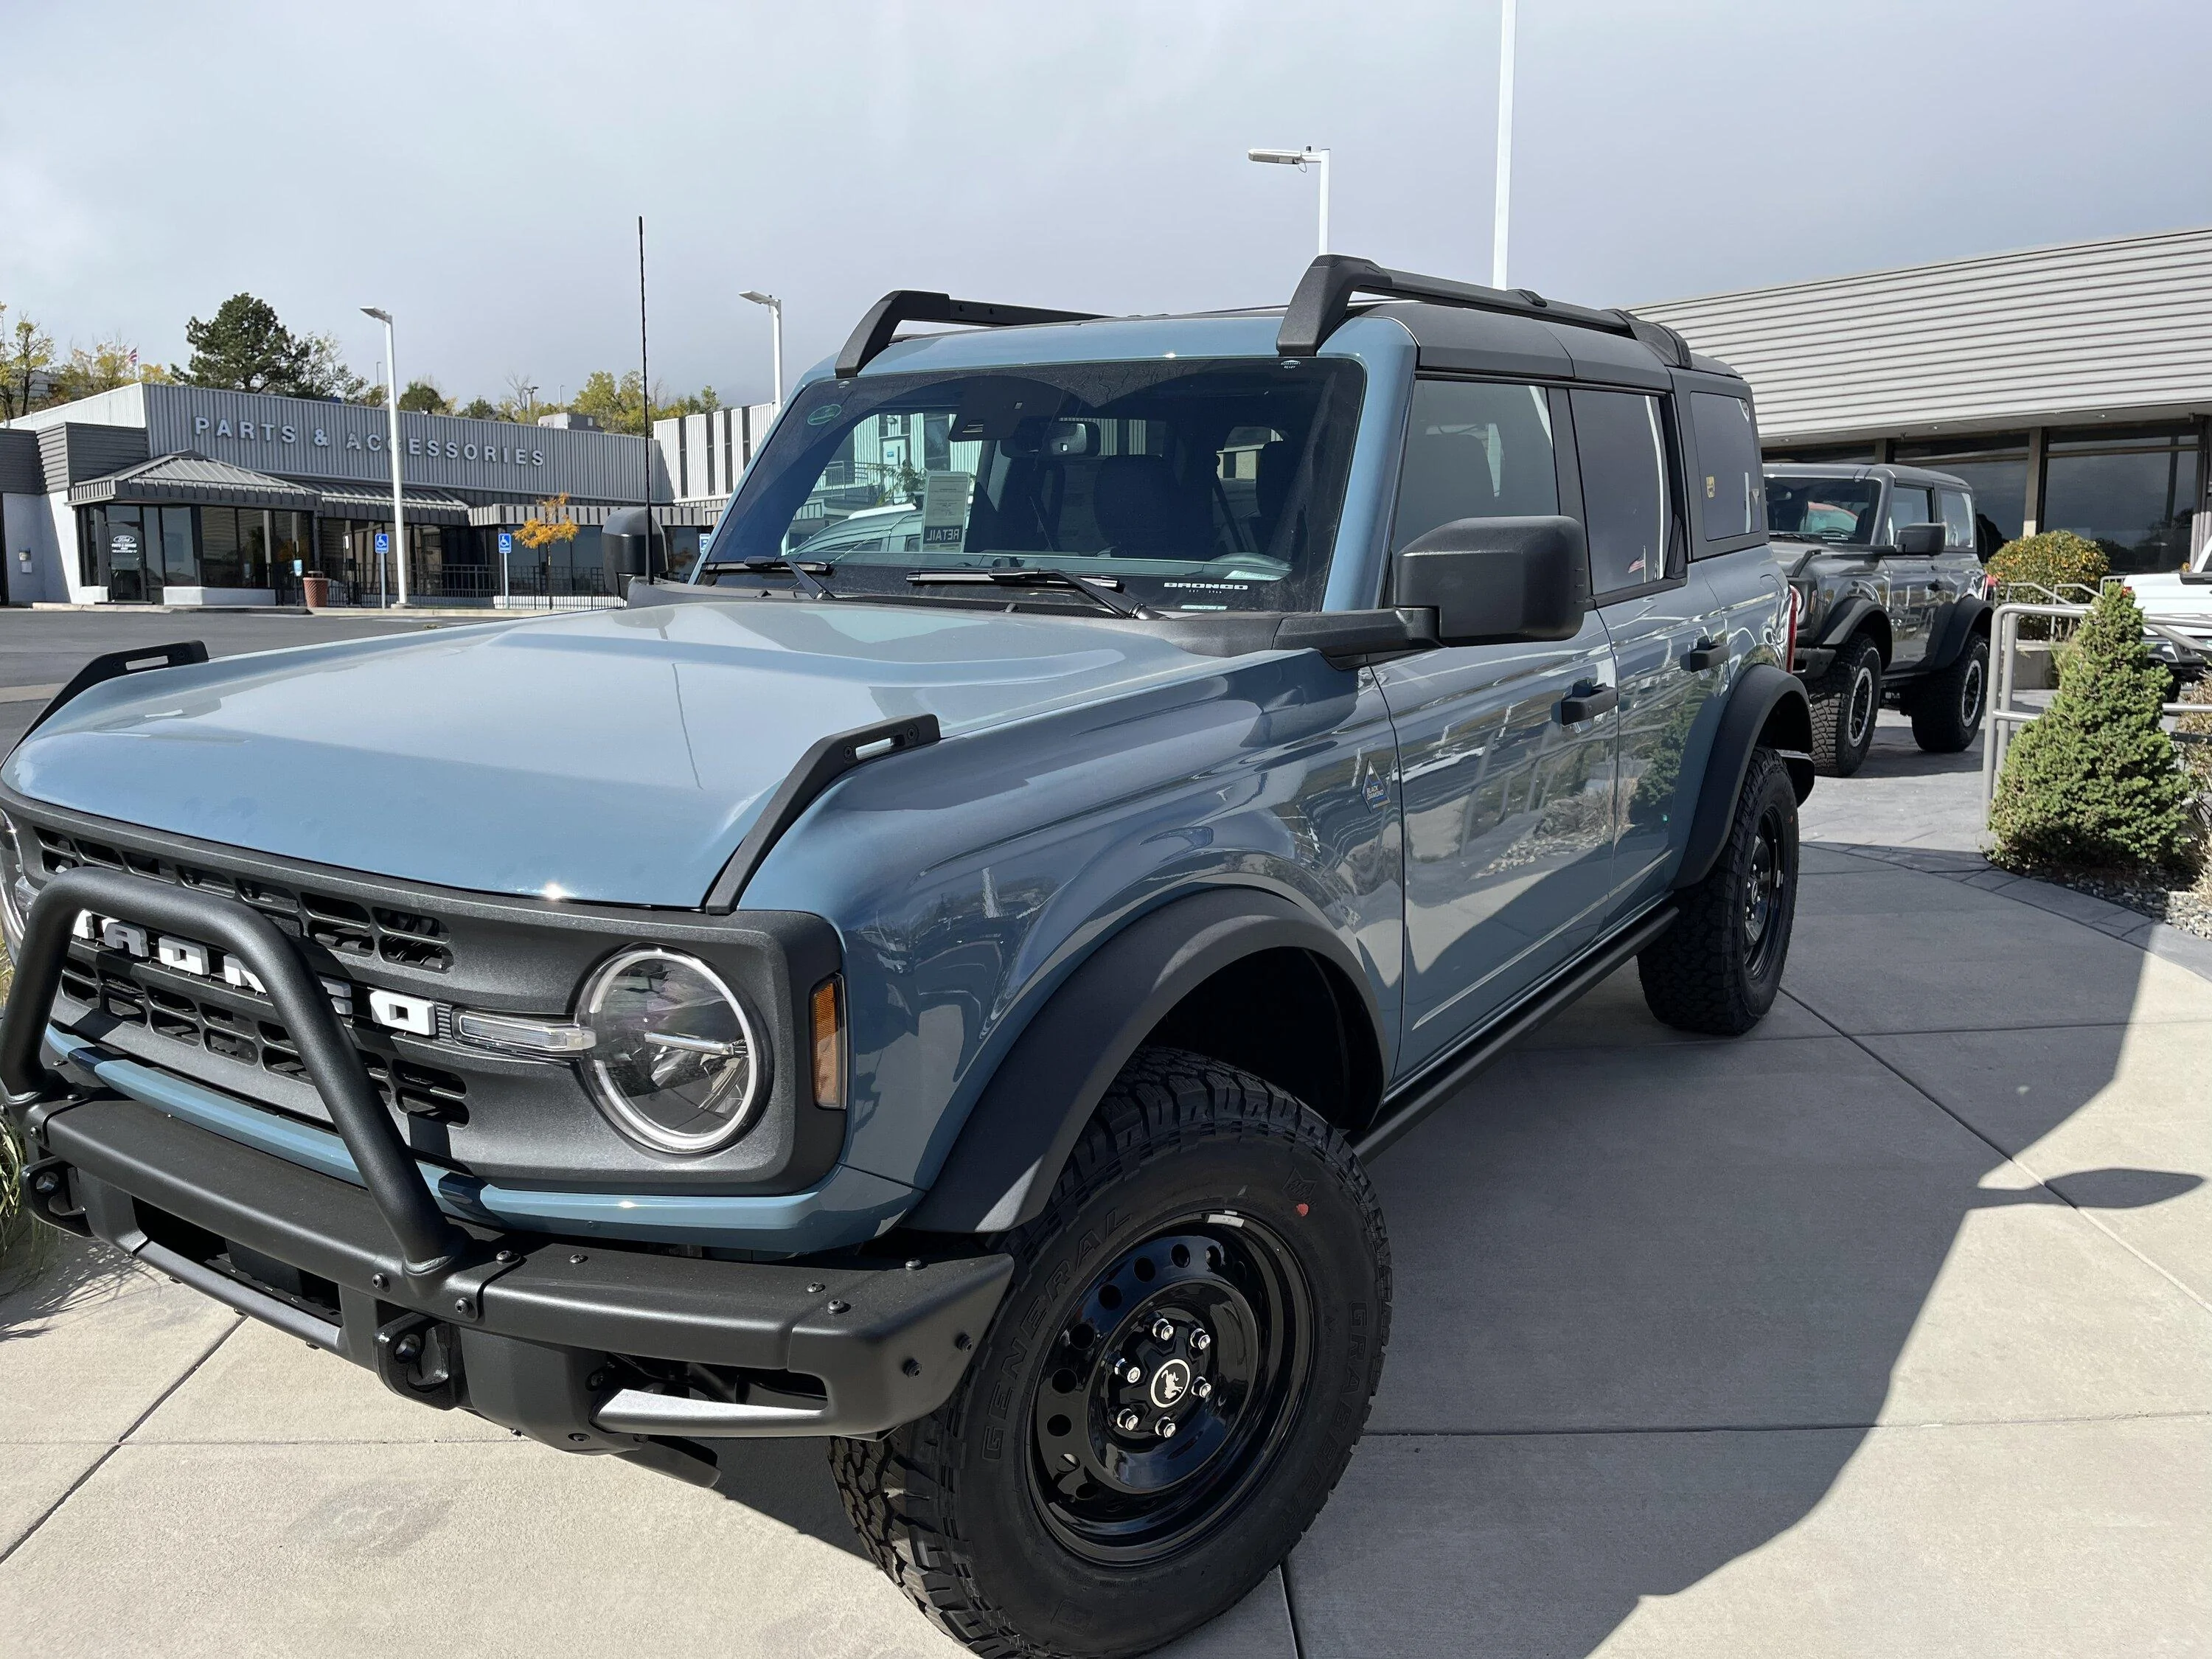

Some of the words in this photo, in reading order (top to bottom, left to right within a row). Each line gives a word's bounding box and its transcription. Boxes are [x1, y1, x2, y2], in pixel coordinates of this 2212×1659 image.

[195, 417, 296, 443] PARTS
[314, 428, 330, 446] &
[1366, 785, 1378, 794] BLACK
[1366, 790, 1384, 800] DIAMOND
[982, 1208, 1132, 1461] GENERAL
